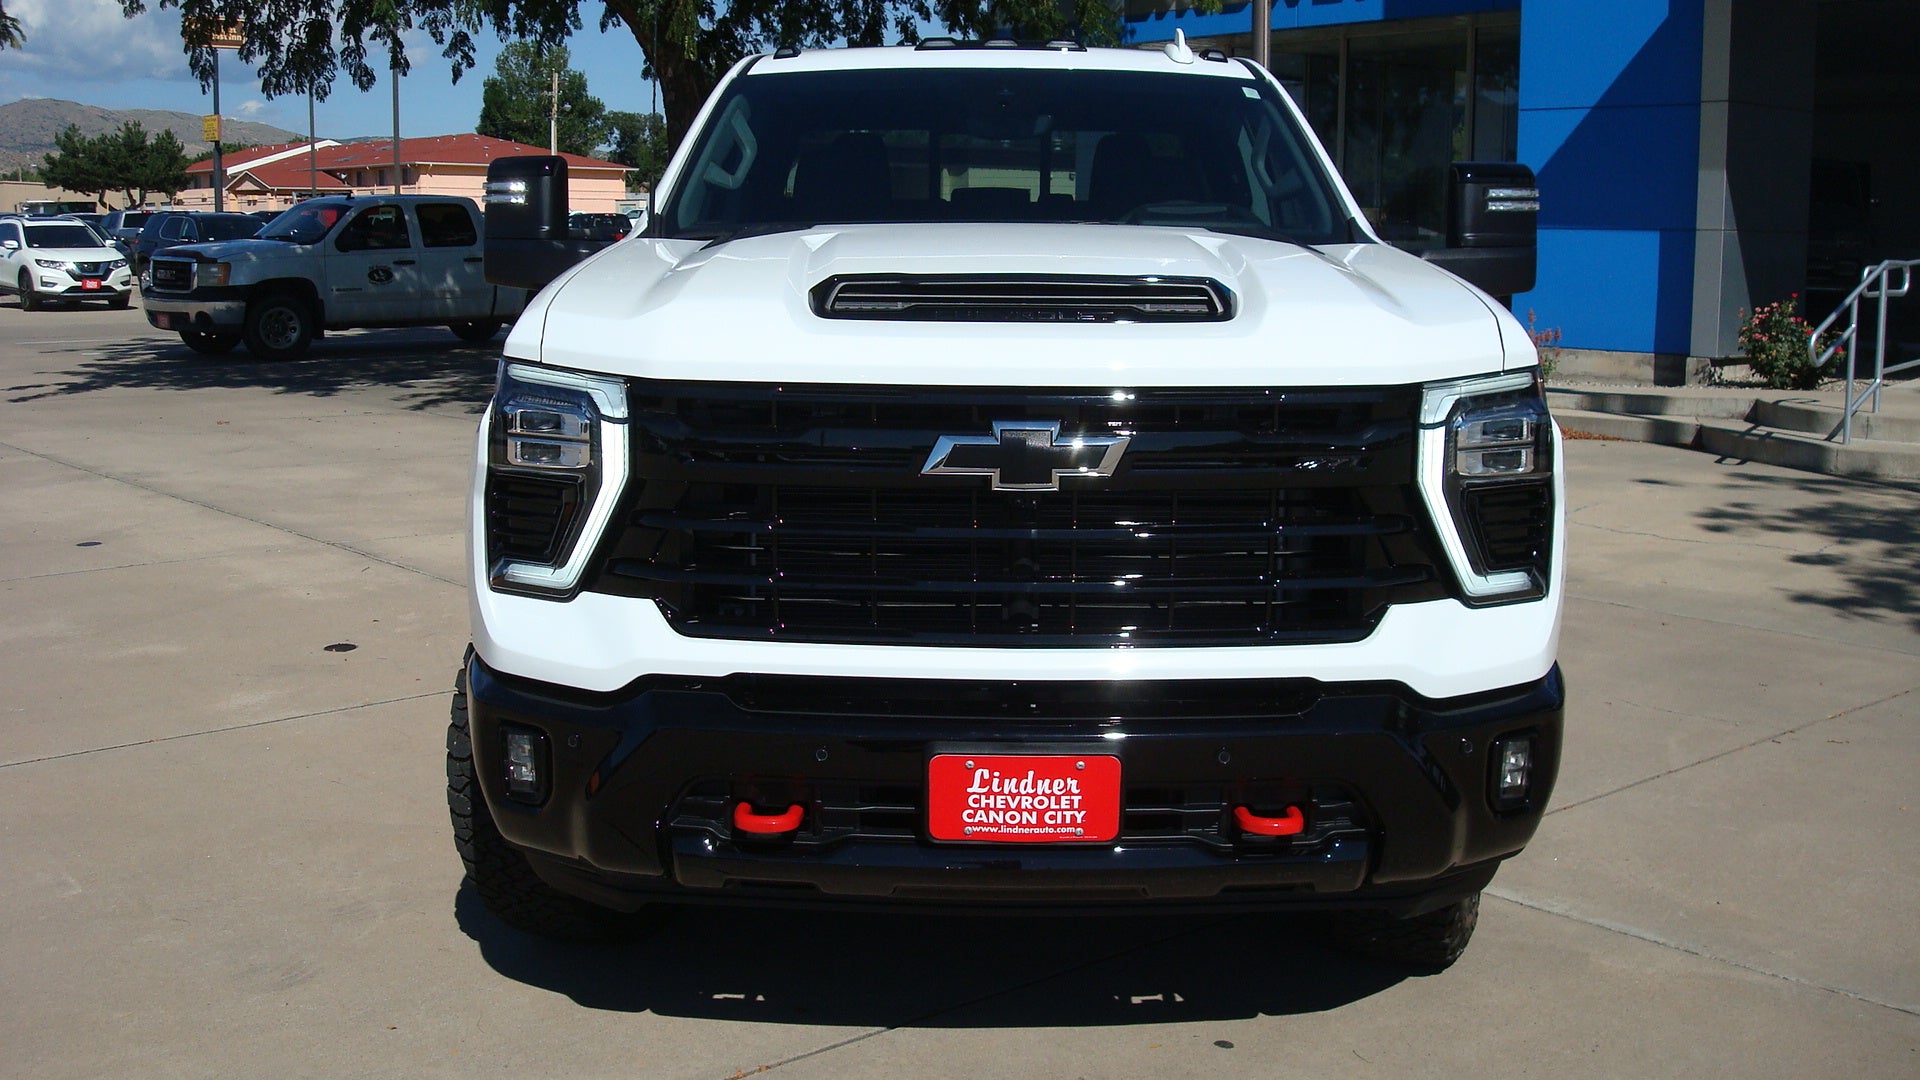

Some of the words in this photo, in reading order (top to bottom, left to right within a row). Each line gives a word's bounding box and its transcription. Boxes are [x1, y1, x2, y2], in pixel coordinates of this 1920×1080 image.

[966, 768, 1081, 795] Lindner
[967, 794, 1083, 810] CHEVROLET
[961, 809, 1037, 825] CANON
[1044, 810, 1087, 825] CITY
[971, 825, 1076, 834] www.lindnerauto.com
